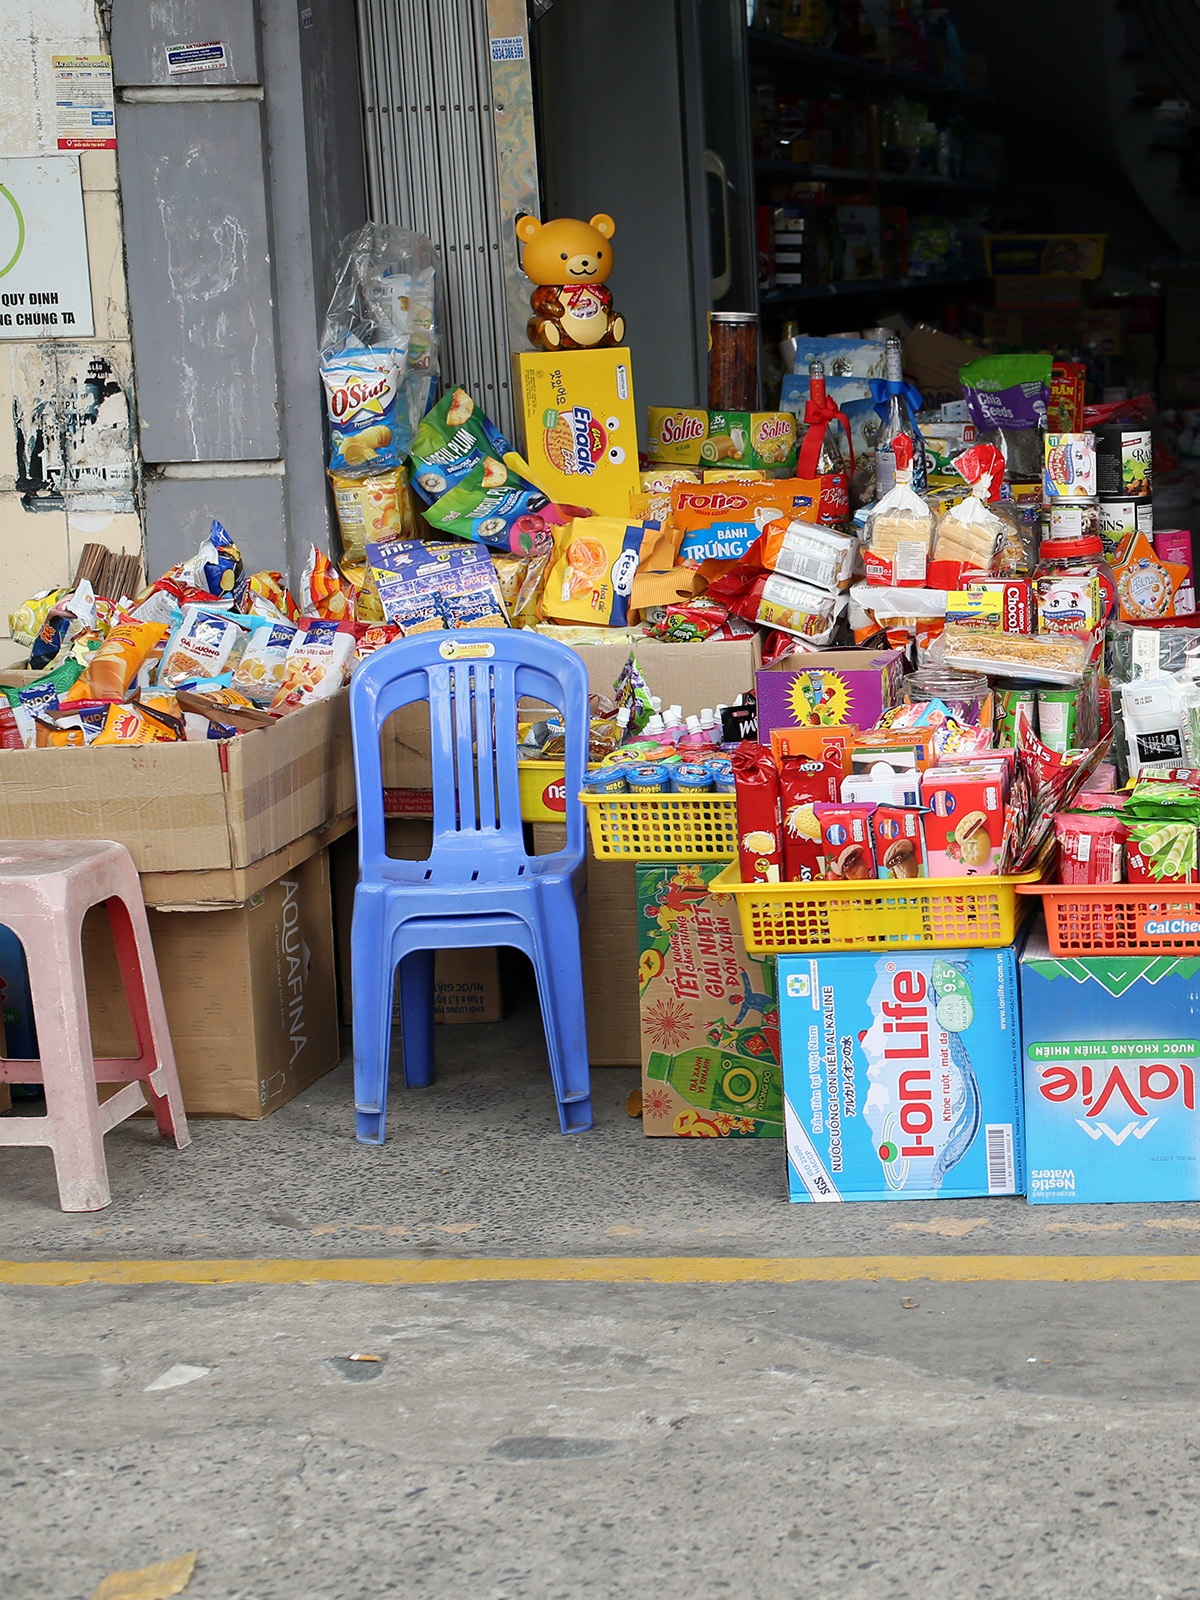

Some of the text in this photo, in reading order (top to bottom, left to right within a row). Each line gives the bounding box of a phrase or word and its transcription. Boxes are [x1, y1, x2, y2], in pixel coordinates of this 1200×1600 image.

[2, 293, 59, 307] QUY ĐỊNH
[16, 311, 75, 325] CHÚNG TA
[978, 392, 1002, 405] Chia
[981, 405, 1014, 418] Seeds
[574, 407, 595, 475] Enaak
[660, 414, 705, 445] Solite
[759, 420, 791, 442] Solite
[717, 525, 748, 540] BÁNH
[684, 540, 743, 560] TRỨNG
[394, 608, 436, 622] Bento
[451, 605, 493, 619] Bento
[799, 761, 824, 773] COSY
[670, 934, 683, 963] KHÔNG
[675, 915, 695, 971] CĂNG THẲNG
[691, 904, 727, 998] GIẢI NHIỆT
[715, 916, 741, 987] ĐÓN XUÂN
[279, 880, 308, 1064] AQUAFINA
[663, 967, 702, 1001] TẾT
[943, 969, 956, 992] 9.5
[996, 953, 1007, 1030] www.ionlife.com.vn
[881, 969, 930, 1060] Life
[939, 1031, 949, 1045] da
[939, 1047, 949, 1067] mát
[1035, 1043, 1195, 1058] NƯỚC KHOÁNG THIÊN NHIÊN
[689, 1056, 702, 1092] TRÀ XANH
[700, 1058, 711, 1084] CHANH
[808, 1025, 823, 1134] Đầu tiên tại Việt Nam
[823, 986, 842, 1171] NƯỚC UỐNG I-ON KIỀM ALKALINE
[841, 1036, 856, 1117] アルカリイオンの水
[756, 1069, 774, 1111] KHÔNG ĐỘ
[1037, 1063, 1196, 1118] laVie
[941, 1096, 952, 1122] Khỏe
[805, 1165, 815, 1177] ISO
[1032, 1169, 1075, 1179] Waters
[814, 1176, 830, 1195] SGS
[1032, 1178, 1075, 1191] Nestlé
